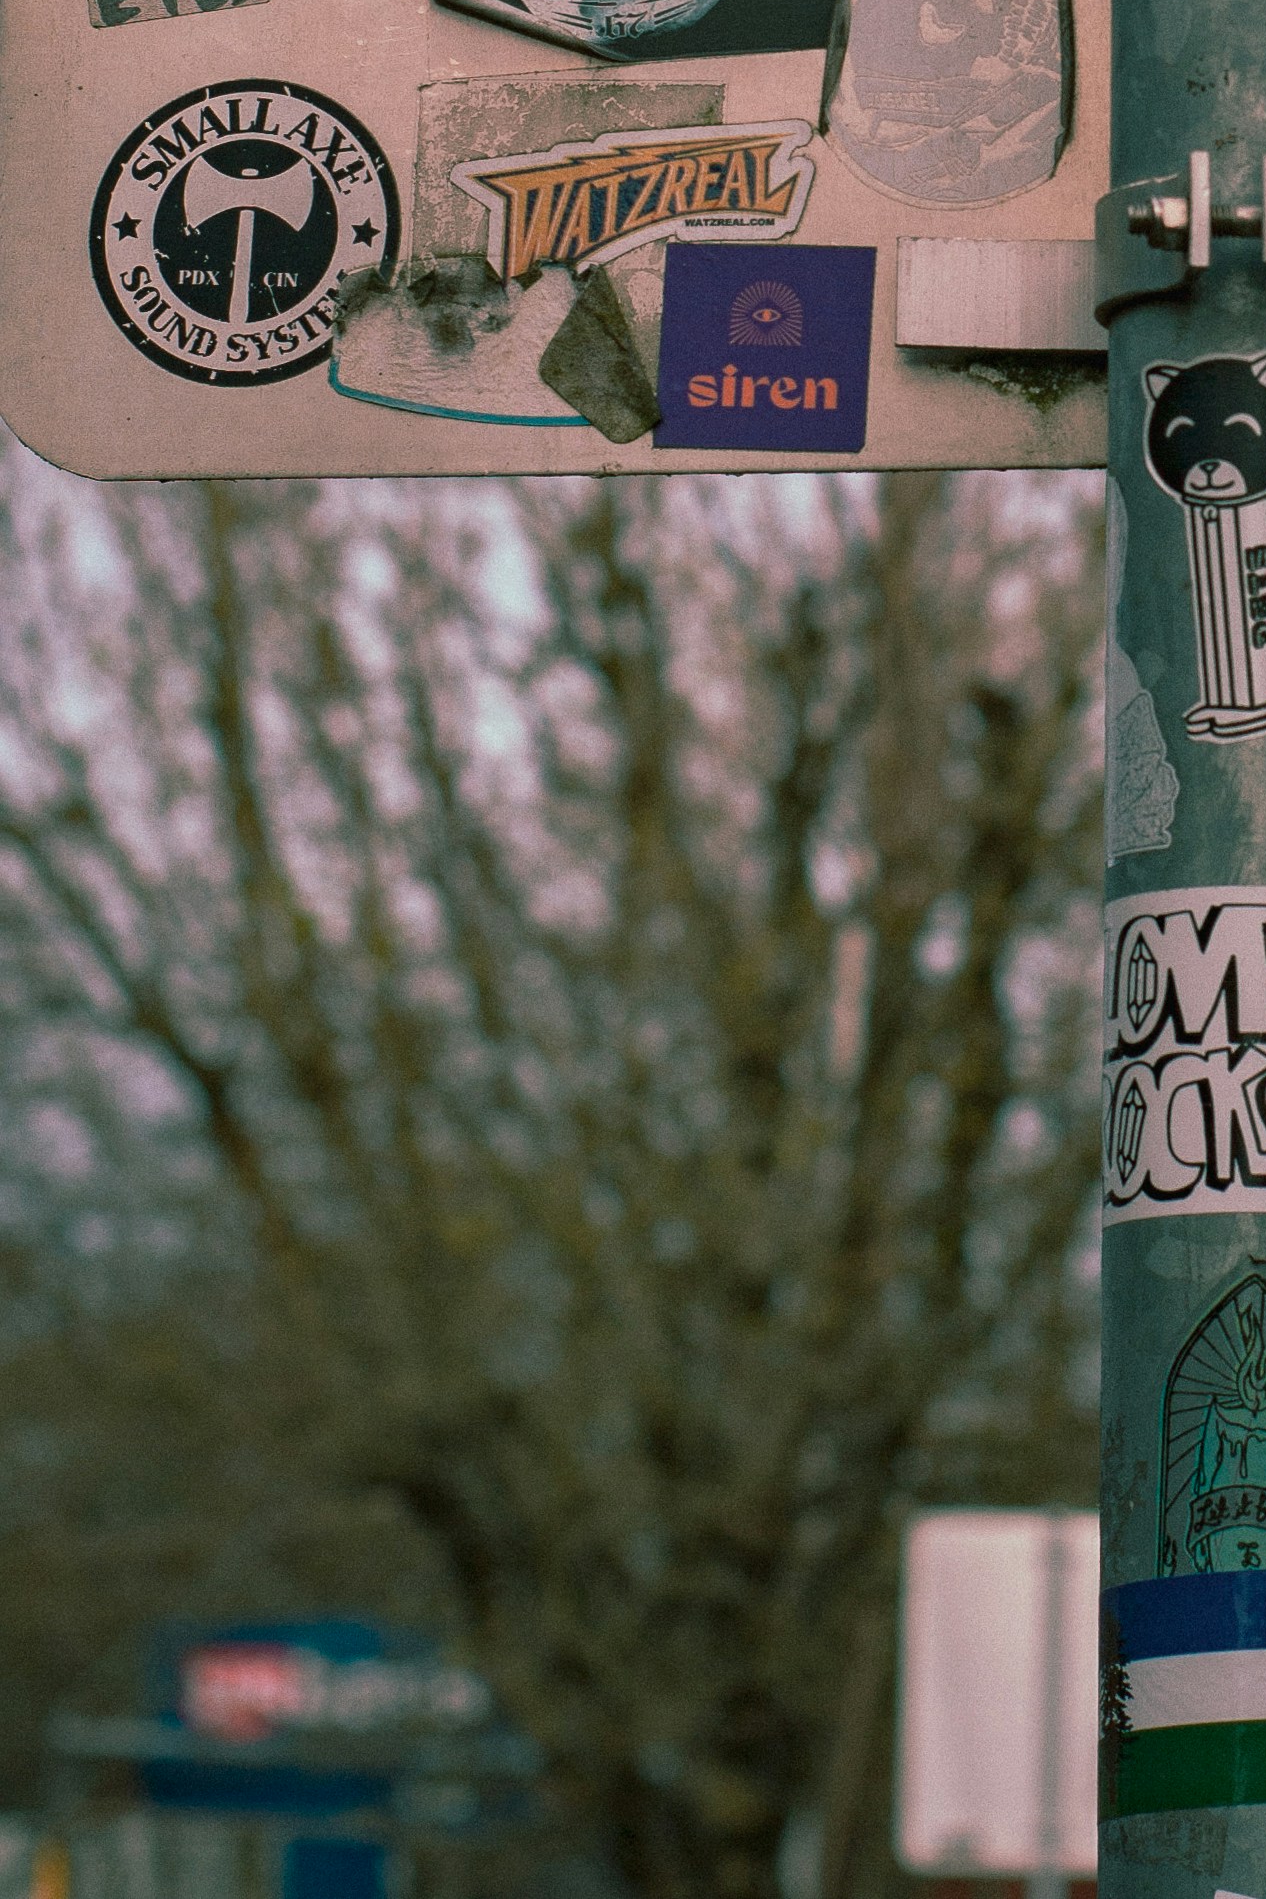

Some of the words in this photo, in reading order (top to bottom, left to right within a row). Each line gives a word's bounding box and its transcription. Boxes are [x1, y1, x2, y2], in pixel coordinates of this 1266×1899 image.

[131, 97, 280, 192] SMALL
[283, 111, 374, 195] AXE
[466, 133, 802, 279] WATZREAL
[684, 217, 776, 228] WATZREAL.COM
[119, 265, 218, 358] SOUND
[178, 269, 221, 287] PDX
[263, 272, 299, 288] CIN
[688, 364, 838, 409] siren
